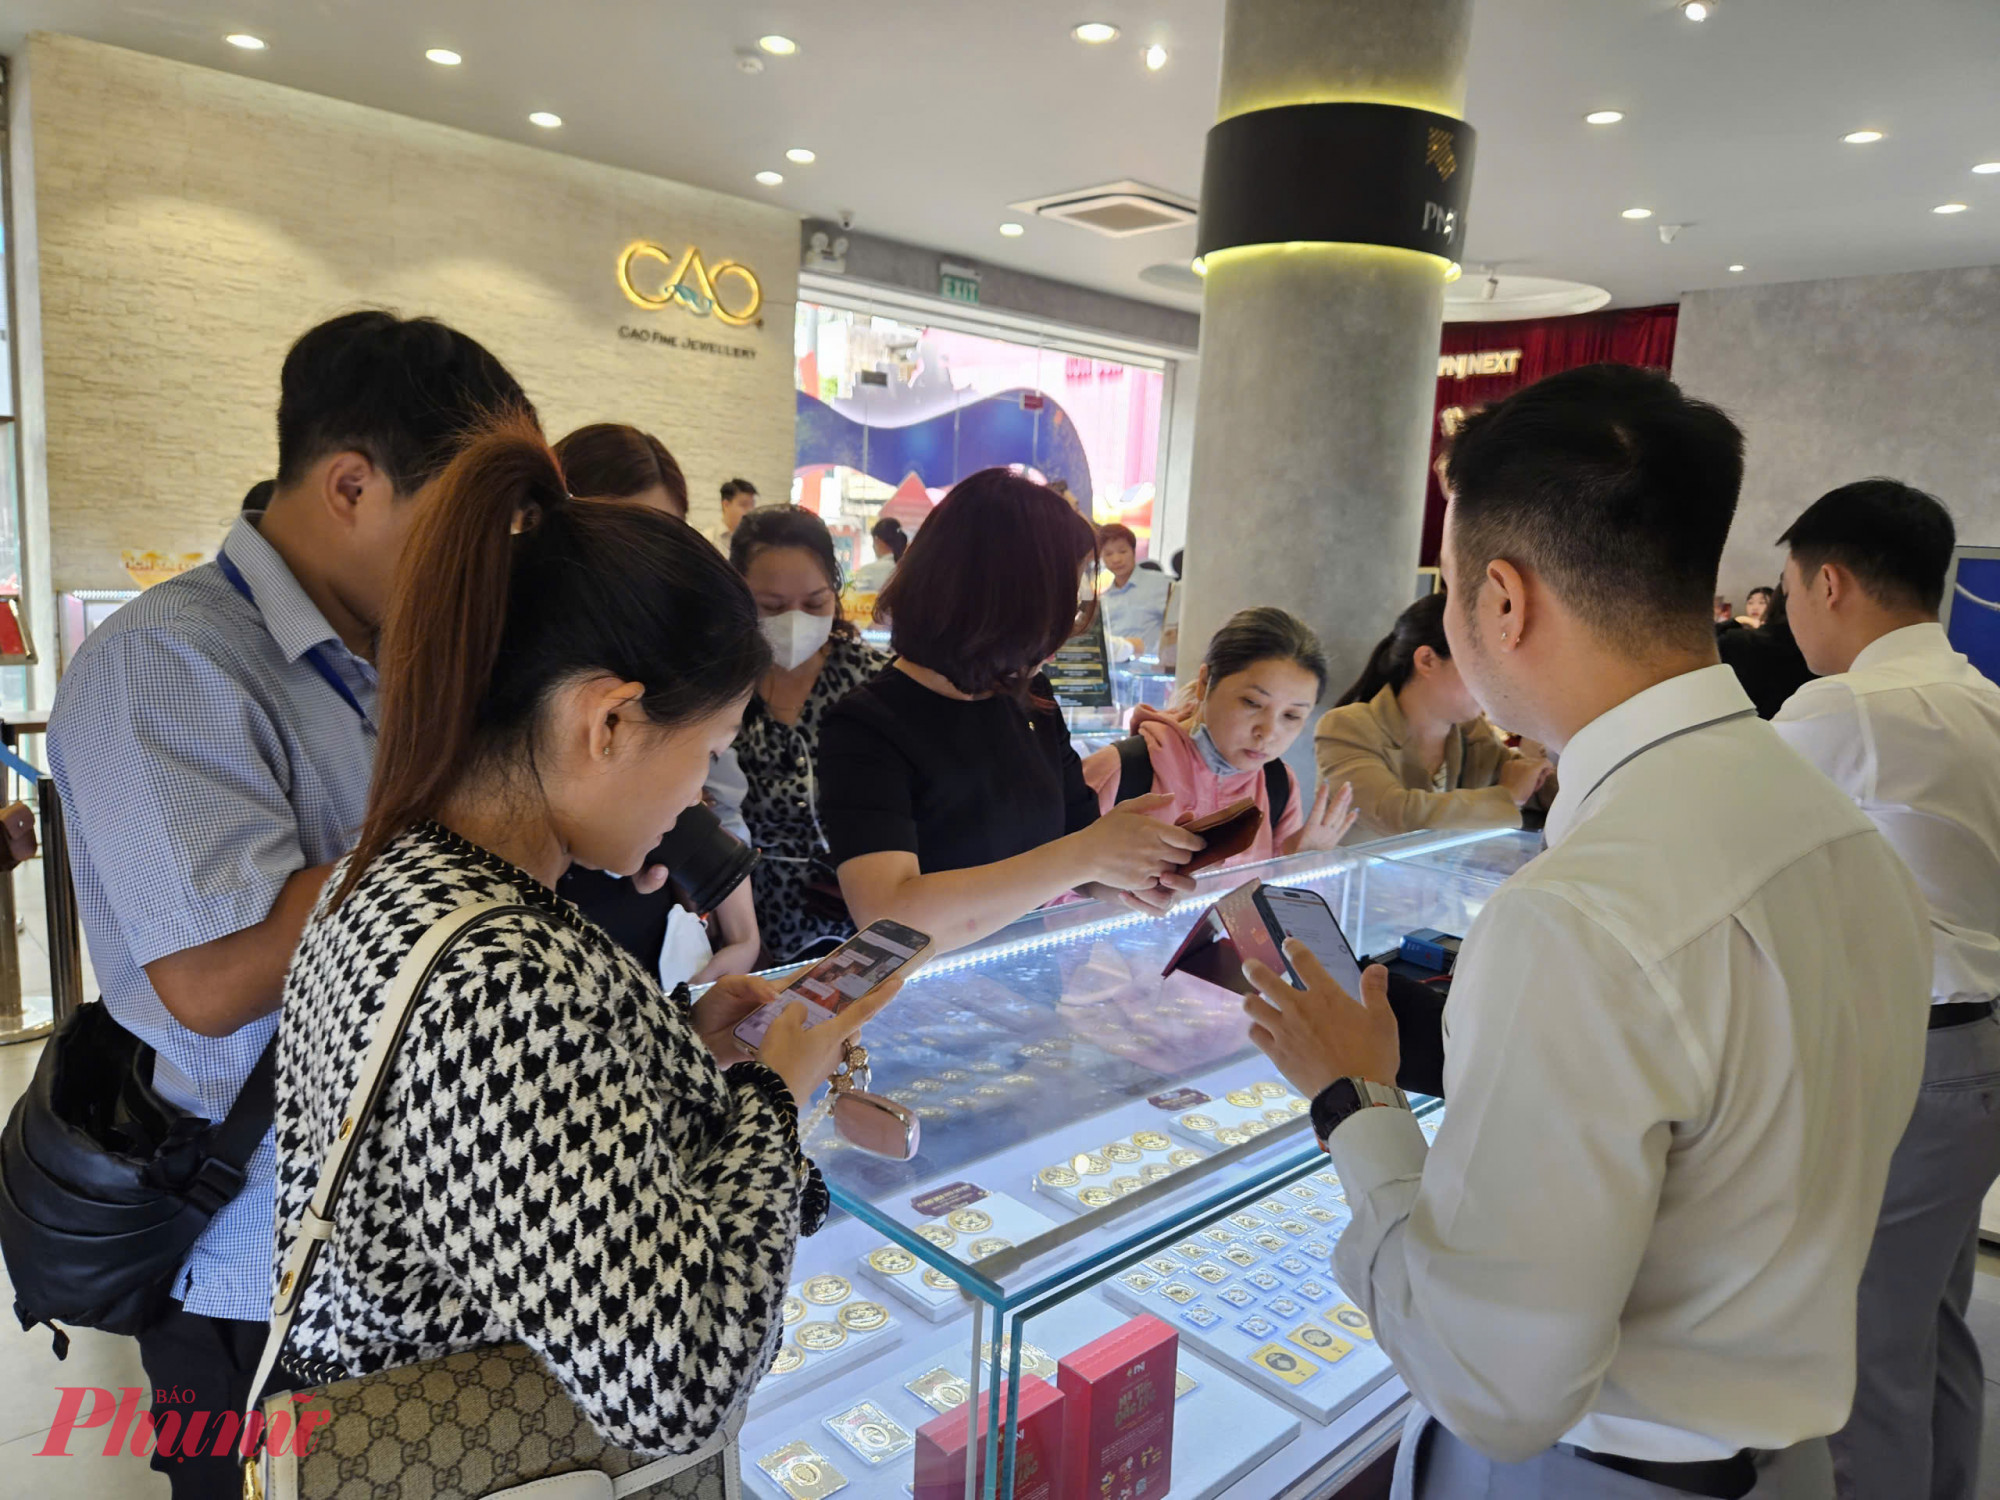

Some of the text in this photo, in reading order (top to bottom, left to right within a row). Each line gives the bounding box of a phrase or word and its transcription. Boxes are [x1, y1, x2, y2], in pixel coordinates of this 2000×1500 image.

[618, 241, 761, 325] CAO
[942, 277, 977, 303] EXIT
[618, 325, 757, 359] CAO FINE JEWELLERY
[1467, 348, 1521, 375] NEXT
